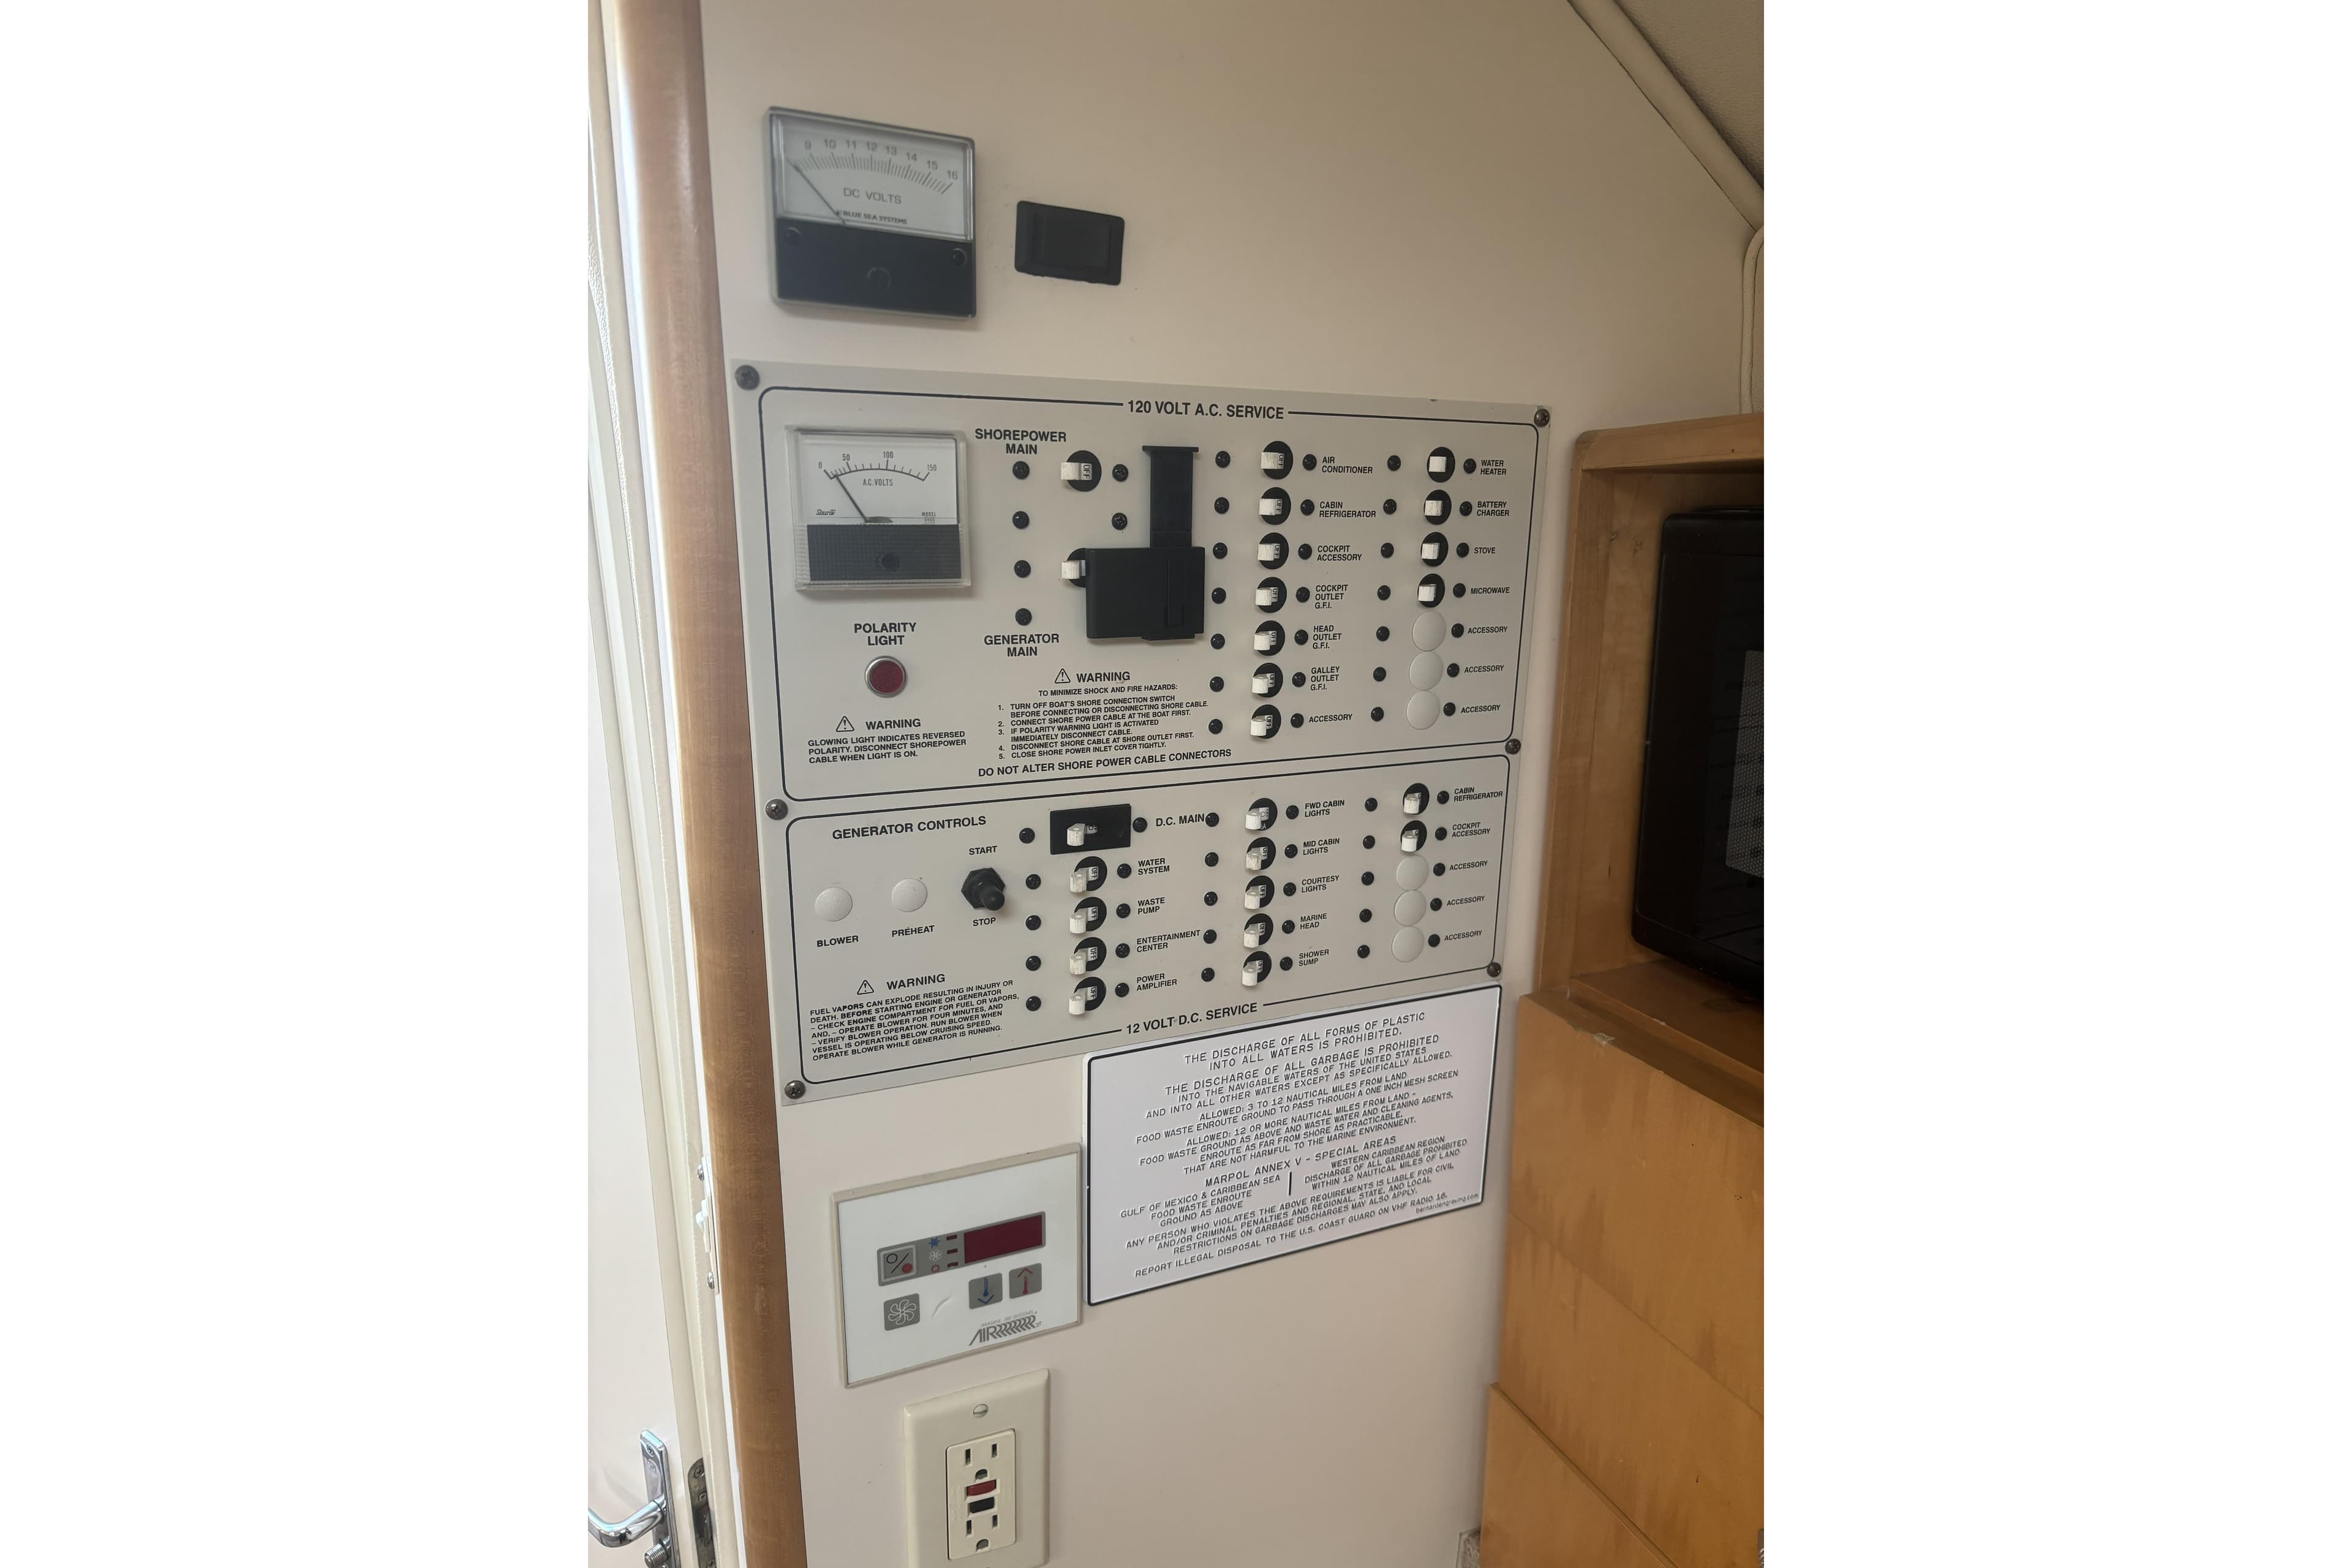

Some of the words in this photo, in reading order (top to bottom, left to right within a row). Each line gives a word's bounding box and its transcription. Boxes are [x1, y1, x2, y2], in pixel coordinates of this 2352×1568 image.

[805, 141, 811, 150] 9
[823, 138, 836, 149] 10
[845, 140, 856, 149] 11
[865, 141, 877, 152] 12
[886, 145, 897, 156] 13
[905, 152, 917, 162] 14
[927, 160, 938, 170] 15
[947, 170, 958, 180] 16
[843, 187, 860, 199] DC
[866, 191, 902, 205] VOLTS
[843, 210, 861, 219] BLUE
[863, 212, 877, 221] SEA
[879, 215, 907, 224] SYSTEMS
[1128, 400, 1151, 413] 120
[1155, 401, 1190, 415] VOLT
[1195, 403, 1221, 416] A.C.
[1226, 404, 1283, 419] SERVICE
[975, 428, 1066, 442] SHOREPOWER
[1006, 443, 1036, 454] MAIN
[854, 622, 916, 633] POLARITY
[868, 635, 904, 645] LIGHT
[984, 633, 1058, 644] GENERATOR
[1007, 646, 1036, 656] MAIN
[1076, 671, 1129, 682] WARNING
[1461, 704, 1500, 713] ACCESSORY
[865, 718, 920, 729] WARNING
[1309, 714, 1352, 722] ACCESSORY
[809, 746, 851, 755] POLARITY.
[854, 742, 907, 752] DISCONNECT
[910, 739, 965, 748] SHOREPOWER
[979, 767, 993, 776] DO
[997, 766, 1019, 775] NOT
[1022, 763, 1054, 772] ALTER
[1058, 760, 1092, 770] SHORE
[1096, 757, 1131, 767] POWER
[1134, 755, 1165, 764] CABLE
[1169, 749, 1231, 761] CONNECTORS
[1454, 791, 1502, 801] REFRIGERATOR
[1323, 799, 1344, 808] CABIN
[1156, 817, 1175, 826] D.C.
[1179, 813, 1204, 824] MAIN
[832, 823, 913, 839] GENERATOR
[918, 816, 986, 831] CONTROLS
[1452, 828, 1490, 837] ACCESSORY
[969, 845, 997, 854] START
[1303, 846, 1328, 855] LIGHTS
[1138, 858, 1165, 867] WATER
[1449, 861, 1487, 870] ACCESSORY
[1138, 865, 1169, 875] SYSTEM
[1302, 875, 1339, 885] COURTESY
[1302, 884, 1326, 892] LIGHTS
[1138, 897, 1164, 906] WASTE
[1447, 895, 1485, 905] ACCESSORY
[973, 917, 995, 926] STOP
[1300, 913, 1327, 922] MARINE
[892, 925, 934, 936] PREHEAT
[1444, 930, 1482, 940] ACCESSORY
[817, 935, 858, 946] BLOWER
[1137, 929, 1200, 944] ENTERTAINMENT
[1137, 942, 1167, 952] CENTER
[1299, 949, 1329, 959] SHOWER
[887, 974, 944, 989] WARNING
[1137, 973, 1164, 983] POWER
[1137, 979, 1177, 990] AMPLIFIER
[1126, 1023, 1139, 1033] 12
[1143, 1016, 1175, 1030] VOLT
[1179, 1012, 1202, 1024] D.C.
[1206, 1002, 1257, 1020] SERVICE
[813, 1050, 848, 1060] OPERATE
[851, 1044, 884, 1054] BLOWER
[886, 1040, 909, 1049] WHILE
[912, 1033, 957, 1044] GENERATOR
[968, 1025, 1002, 1035] RUNNING.
[1185, 1052, 1206, 1063] THE
[1213, 1039, 1275, 1058] DISCHARGE
[1281, 1036, 1294, 1046] OF
[1300, 1031, 1320, 1042] ALL
[1325, 1024, 1359, 1038] FORMS
[1365, 1020, 1378, 1031] OF
[1383, 1012, 1425, 1028] PLASTIC
[1210, 1058, 1235, 1070] INTO
[1242, 1054, 1263, 1064] ALL
[1270, 1043, 1313, 1058] WATERS
[1319, 1040, 1328, 1049] IS
[1335, 1027, 1401, 1046] PROHIBITED.
[1205, 1170, 1249, 1186] MARPOL
[1254, 1160, 1290, 1175] ANNEX
[1315, 1145, 1358, 1161] SPECIAL
[1363, 1136, 1395, 1150] AREAS
